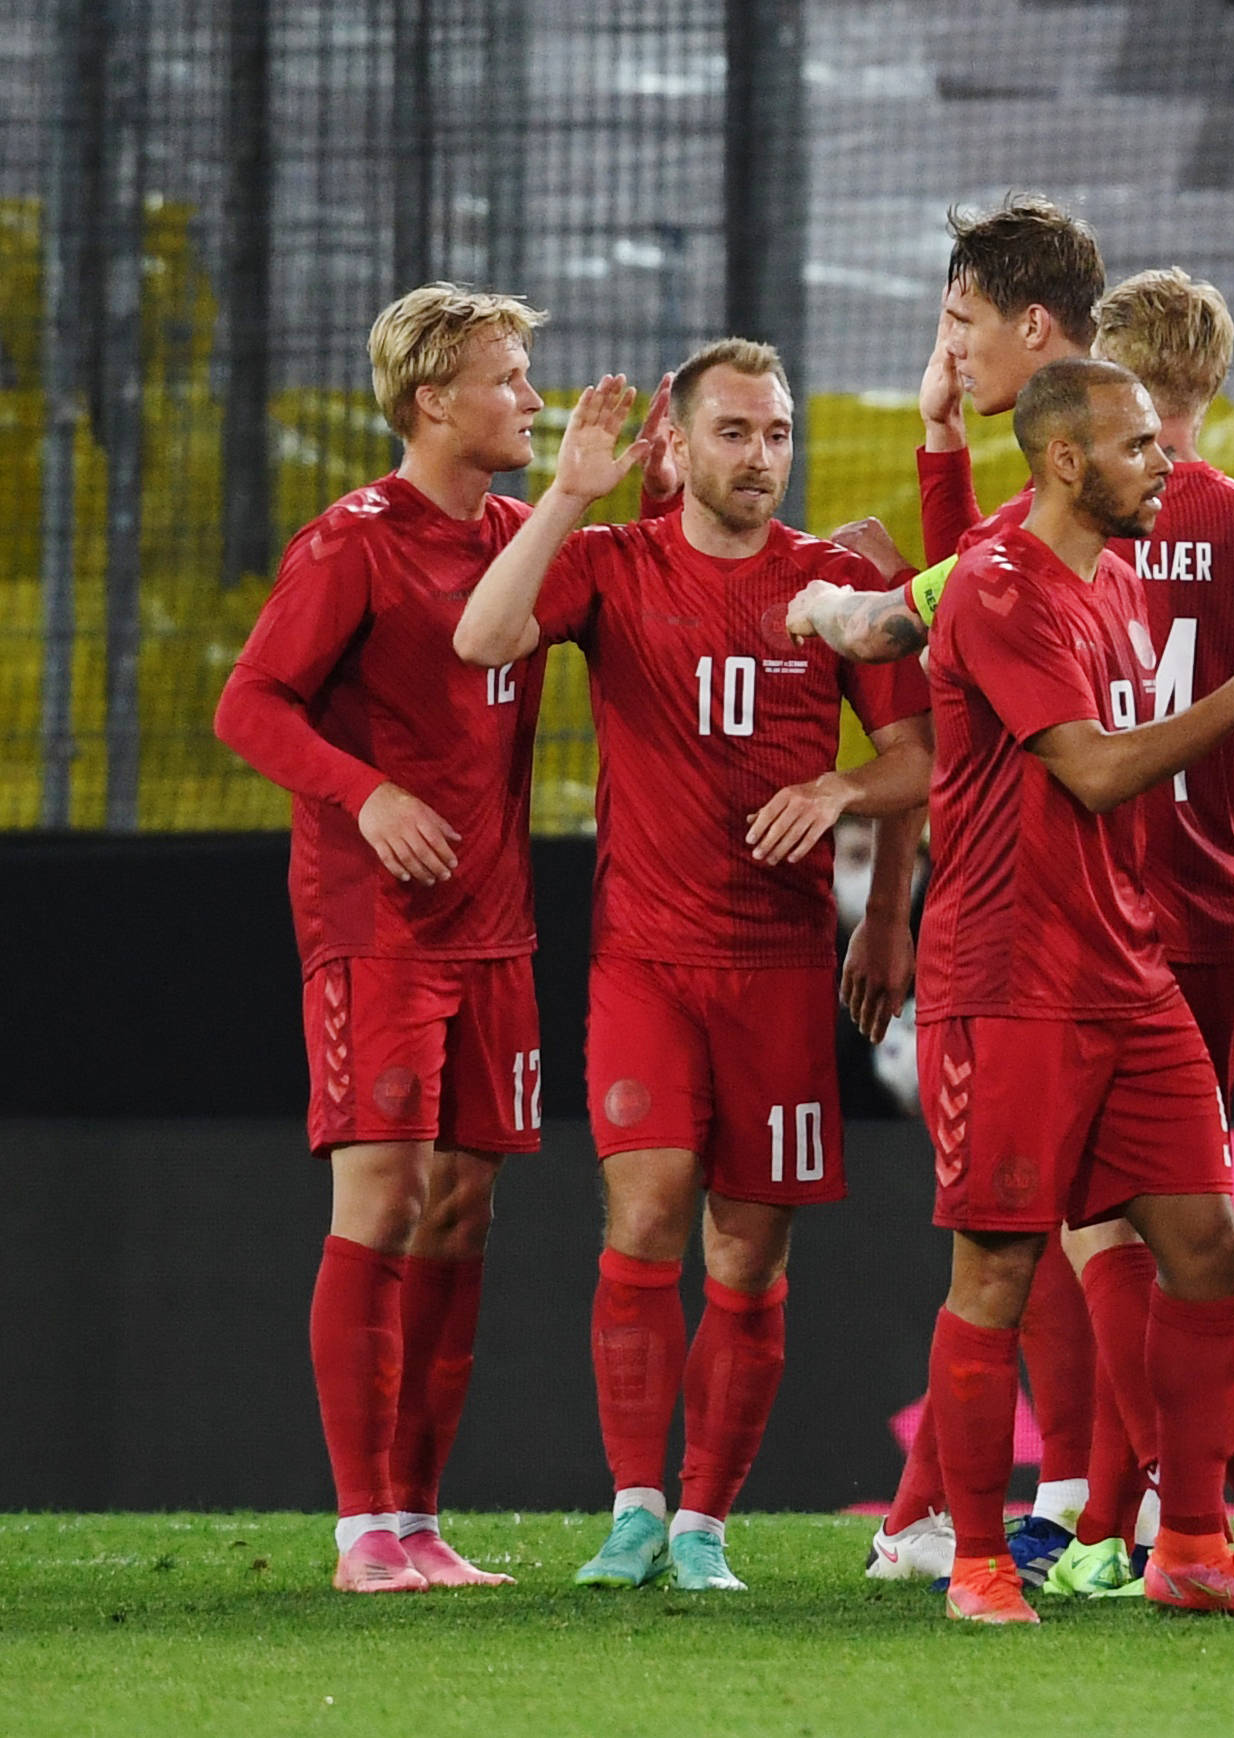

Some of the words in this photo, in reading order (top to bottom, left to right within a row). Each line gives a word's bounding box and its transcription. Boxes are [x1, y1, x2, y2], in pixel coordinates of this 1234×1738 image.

[1134, 539, 1213, 582] KJÆR
[695, 655, 756, 737] 10
[767, 1102, 824, 1182] 10
